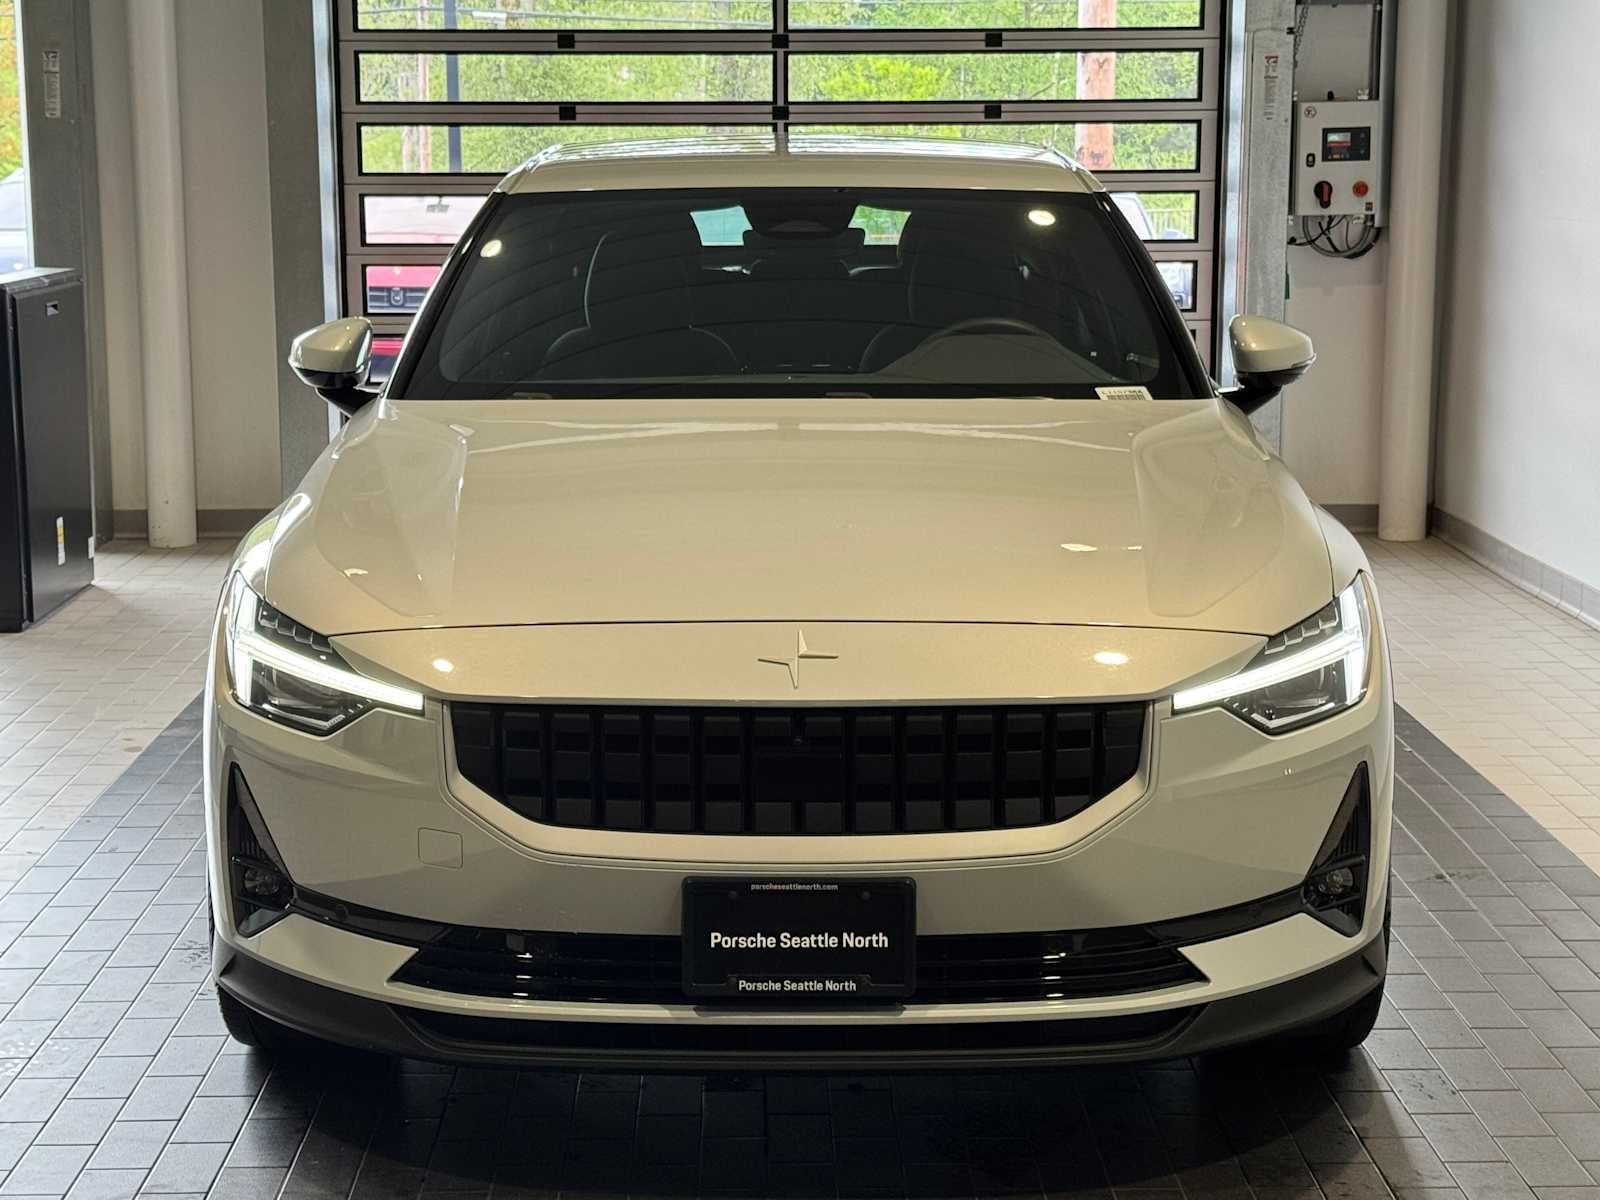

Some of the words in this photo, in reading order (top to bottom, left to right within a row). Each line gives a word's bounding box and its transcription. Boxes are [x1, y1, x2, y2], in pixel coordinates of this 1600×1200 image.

[750, 882, 839, 891] porscheseattlenorth.com
[710, 931, 777, 949] Porsche
[779, 931, 839, 949] Seattle
[842, 931, 889, 949] North
[738, 979, 782, 992] Porsche
[783, 979, 824, 992] Seattle
[825, 979, 857, 992] North
